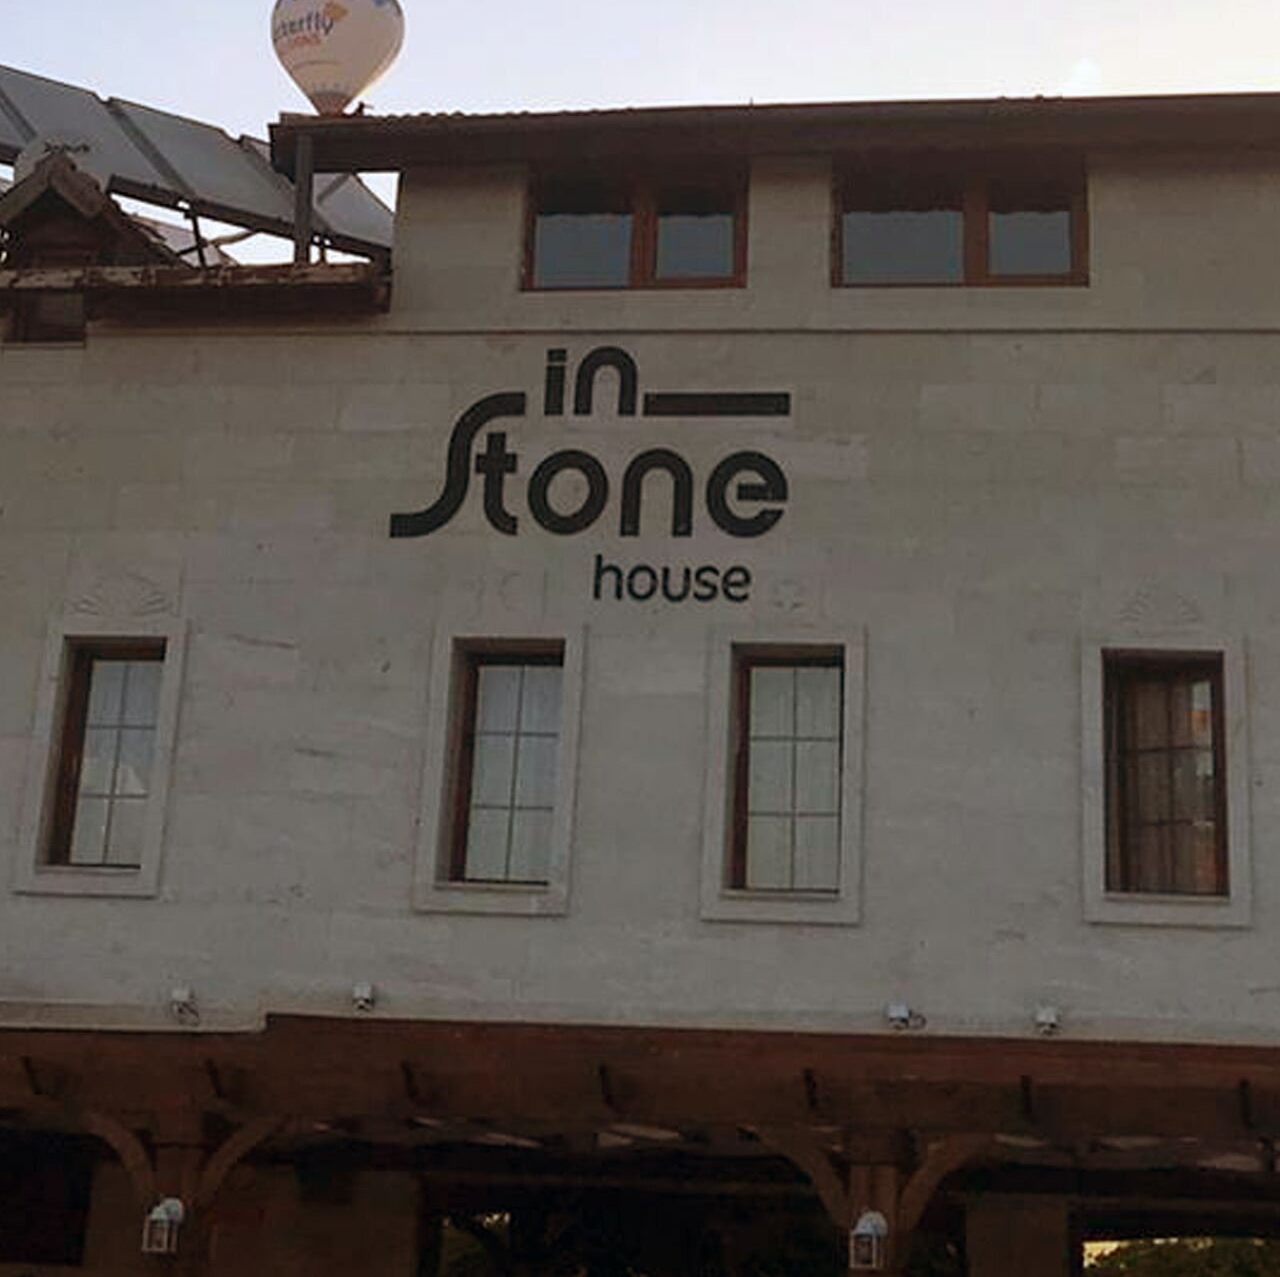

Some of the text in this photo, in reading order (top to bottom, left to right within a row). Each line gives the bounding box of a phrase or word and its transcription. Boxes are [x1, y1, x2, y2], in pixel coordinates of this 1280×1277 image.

[543, 345, 638, 416] in
[389, 391, 789, 538] Stone
[592, 554, 752, 603] house
